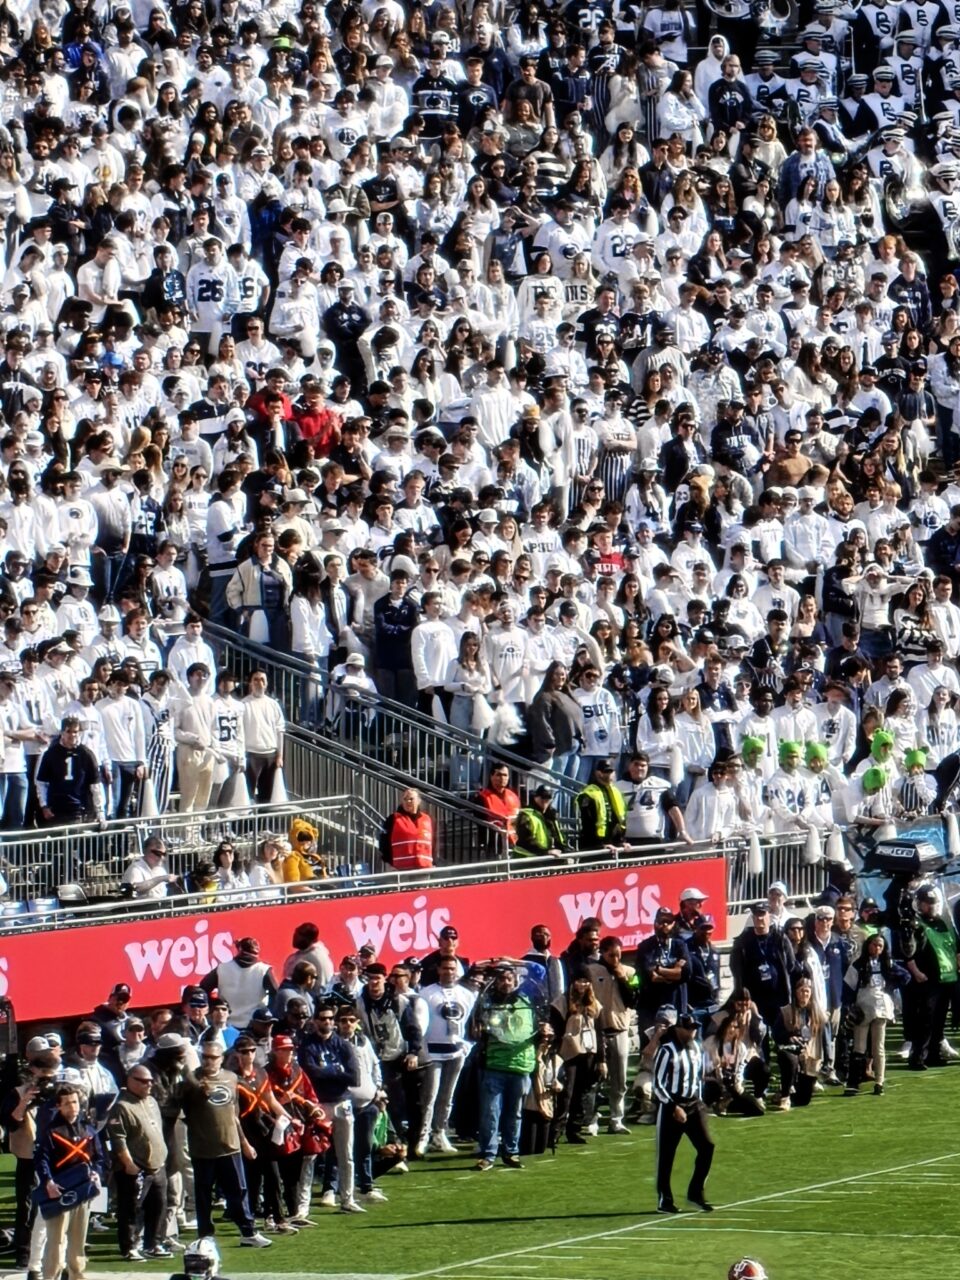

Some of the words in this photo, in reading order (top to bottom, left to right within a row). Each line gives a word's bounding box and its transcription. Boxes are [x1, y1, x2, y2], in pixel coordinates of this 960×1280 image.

[198, 279, 224, 302] 26
[64, 757, 74, 780] 1
[345, 895, 450, 958] weis
[558, 873, 661, 934] weis
[124, 919, 234, 982] weis
